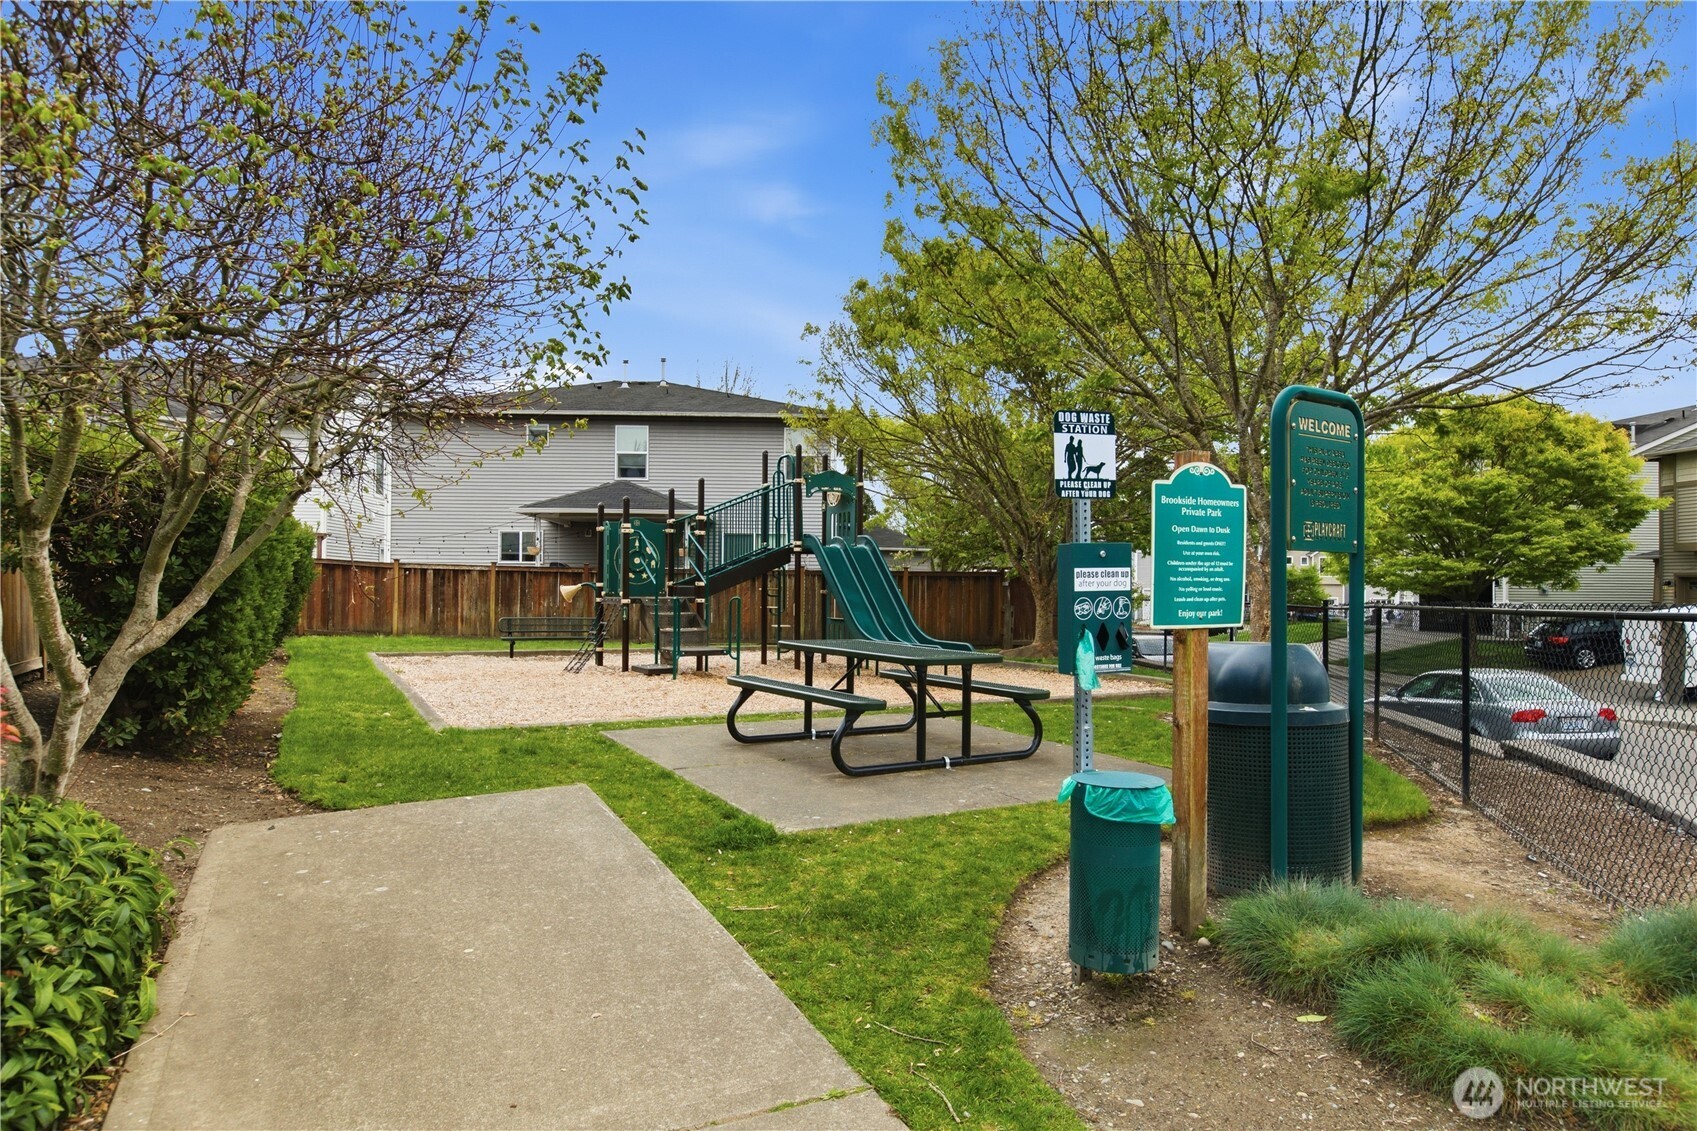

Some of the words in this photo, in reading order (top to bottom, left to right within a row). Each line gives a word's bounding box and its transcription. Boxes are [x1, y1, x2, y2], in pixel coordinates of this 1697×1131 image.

[1058, 412, 1077, 422] DOG
[1080, 412, 1110, 424] WASTE
[1062, 424, 1108, 434] STATION
[1298, 416, 1351, 438] WELCOME
[1061, 490, 1080, 498] AFTER
[1161, 496, 1196, 506] Brookside
[1198, 497, 1240, 507] Homeowners
[1182, 507, 1206, 516] Private
[1207, 508, 1222, 517] Park
[1172, 524, 1190, 534] Open
[1191, 525, 1208, 533] Dawn
[1314, 522, 1346, 538] PLAYCRAFT
[1076, 570, 1099, 579] please
[1100, 569, 1119, 578] clean
[1096, 580, 1112, 588] your
[1113, 579, 1127, 589] dog
[1178, 609, 1195, 619] Enjoy
[1208, 609, 1223, 618] park!
